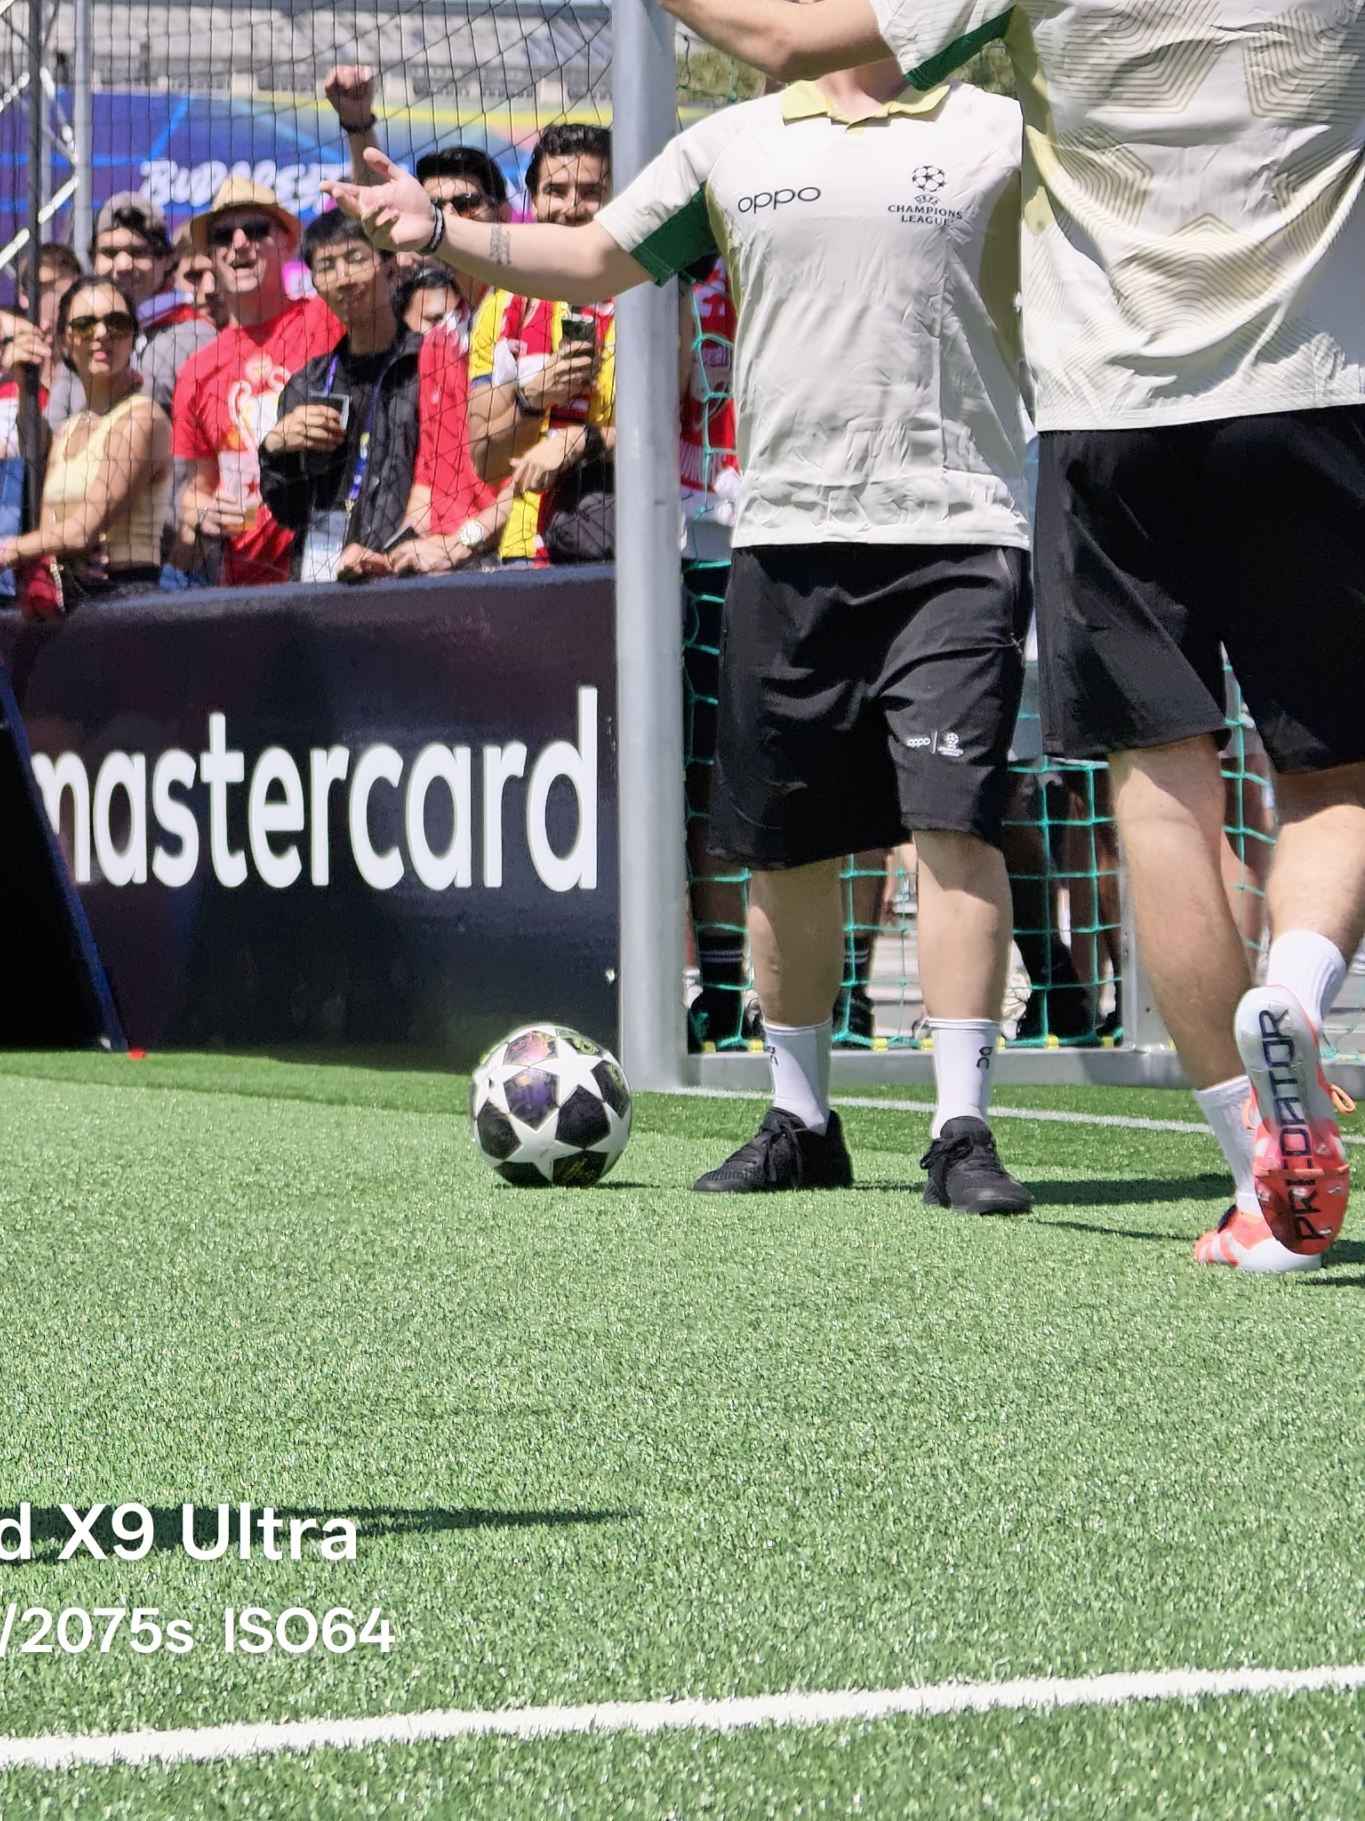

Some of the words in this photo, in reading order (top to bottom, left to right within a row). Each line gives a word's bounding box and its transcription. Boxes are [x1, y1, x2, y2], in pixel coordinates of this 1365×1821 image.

[888, 204, 963, 220] CHAMPIONS
[901, 215, 951, 227] LEAGUE
[31, 687, 598, 893] mastercard
[1258, 1008, 1330, 1241] PREDATOR
